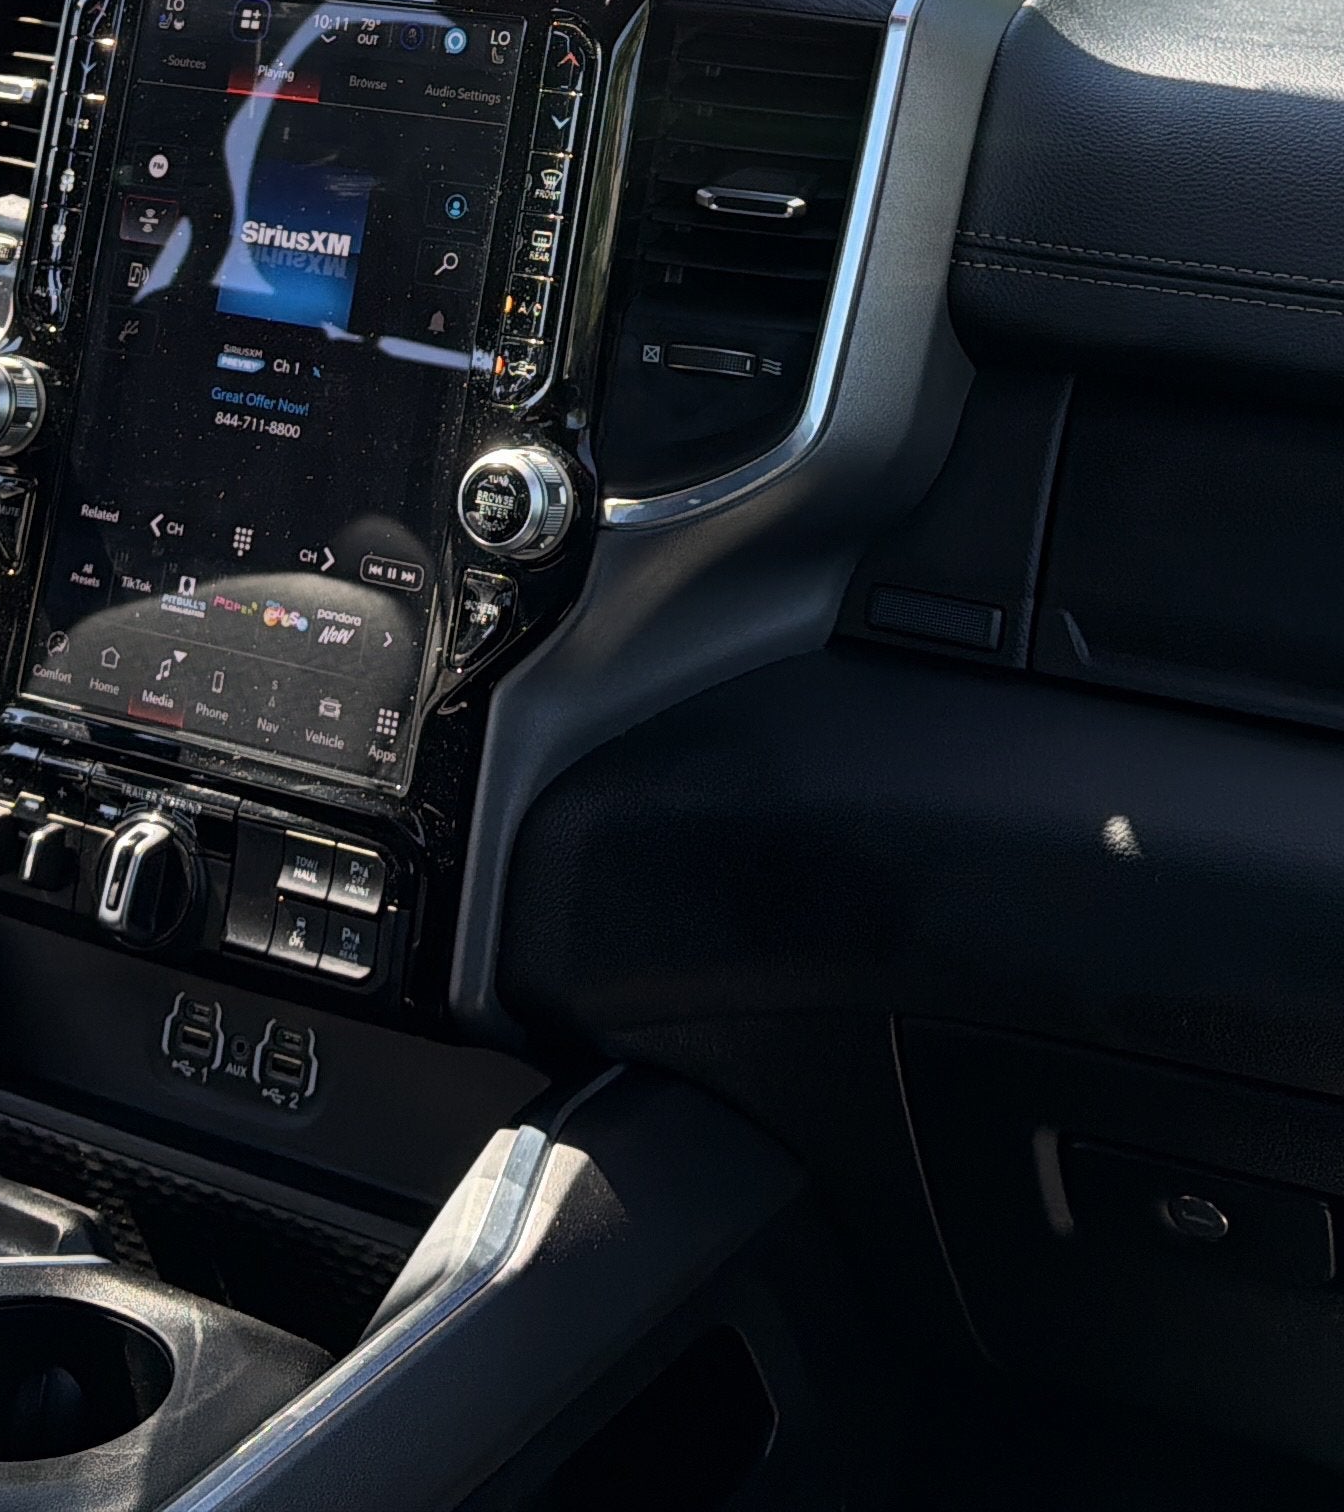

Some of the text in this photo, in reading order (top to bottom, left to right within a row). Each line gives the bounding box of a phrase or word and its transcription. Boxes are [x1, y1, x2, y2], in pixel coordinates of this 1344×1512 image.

[313, 14, 349, 31] 10:11
[357, 33, 379, 46] OUT
[490, 30, 511, 46] LO
[168, 54, 207, 70] Sources
[257, 65, 295, 82] Playing
[349, 75, 387, 90] Browse
[425, 83, 501, 104] Audio Settings
[534, 189, 560, 200] FRONT
[241, 220, 352, 257] SiriusXM
[529, 251, 550, 263] REAR
[518, 302, 543, 316] A/C
[273, 358, 300, 375] Ch 1
[211, 387, 309, 416] Great Offer Now!
[215, 411, 300, 438] 844-711-8800
[477, 490, 514, 506] BROWSE
[81, 503, 120, 523] Related
[480, 505, 508, 520] ENTER
[166, 522, 184, 536] CH
[299, 549, 317, 564] CH
[83, 564, 94, 574] All
[70, 572, 101, 588] Presets
[122, 576, 153, 593] TikTok
[162, 594, 206, 610] PITBULL'S
[317, 608, 362, 627] pandora
[32, 664, 72, 685] Comfort
[89, 677, 120, 695] Home
[142, 690, 174, 709] Media
[196, 702, 229, 721] Phone
[257, 717, 280, 734] Nav
[305, 728, 345, 750] Vehicle
[368, 745, 397, 763] Apps
[293, 868, 317, 883] HAUL
[202, 1067, 208, 1084] 1
[225, 1062, 247, 1078] AUX
[289, 1092, 299, 1109] 2
